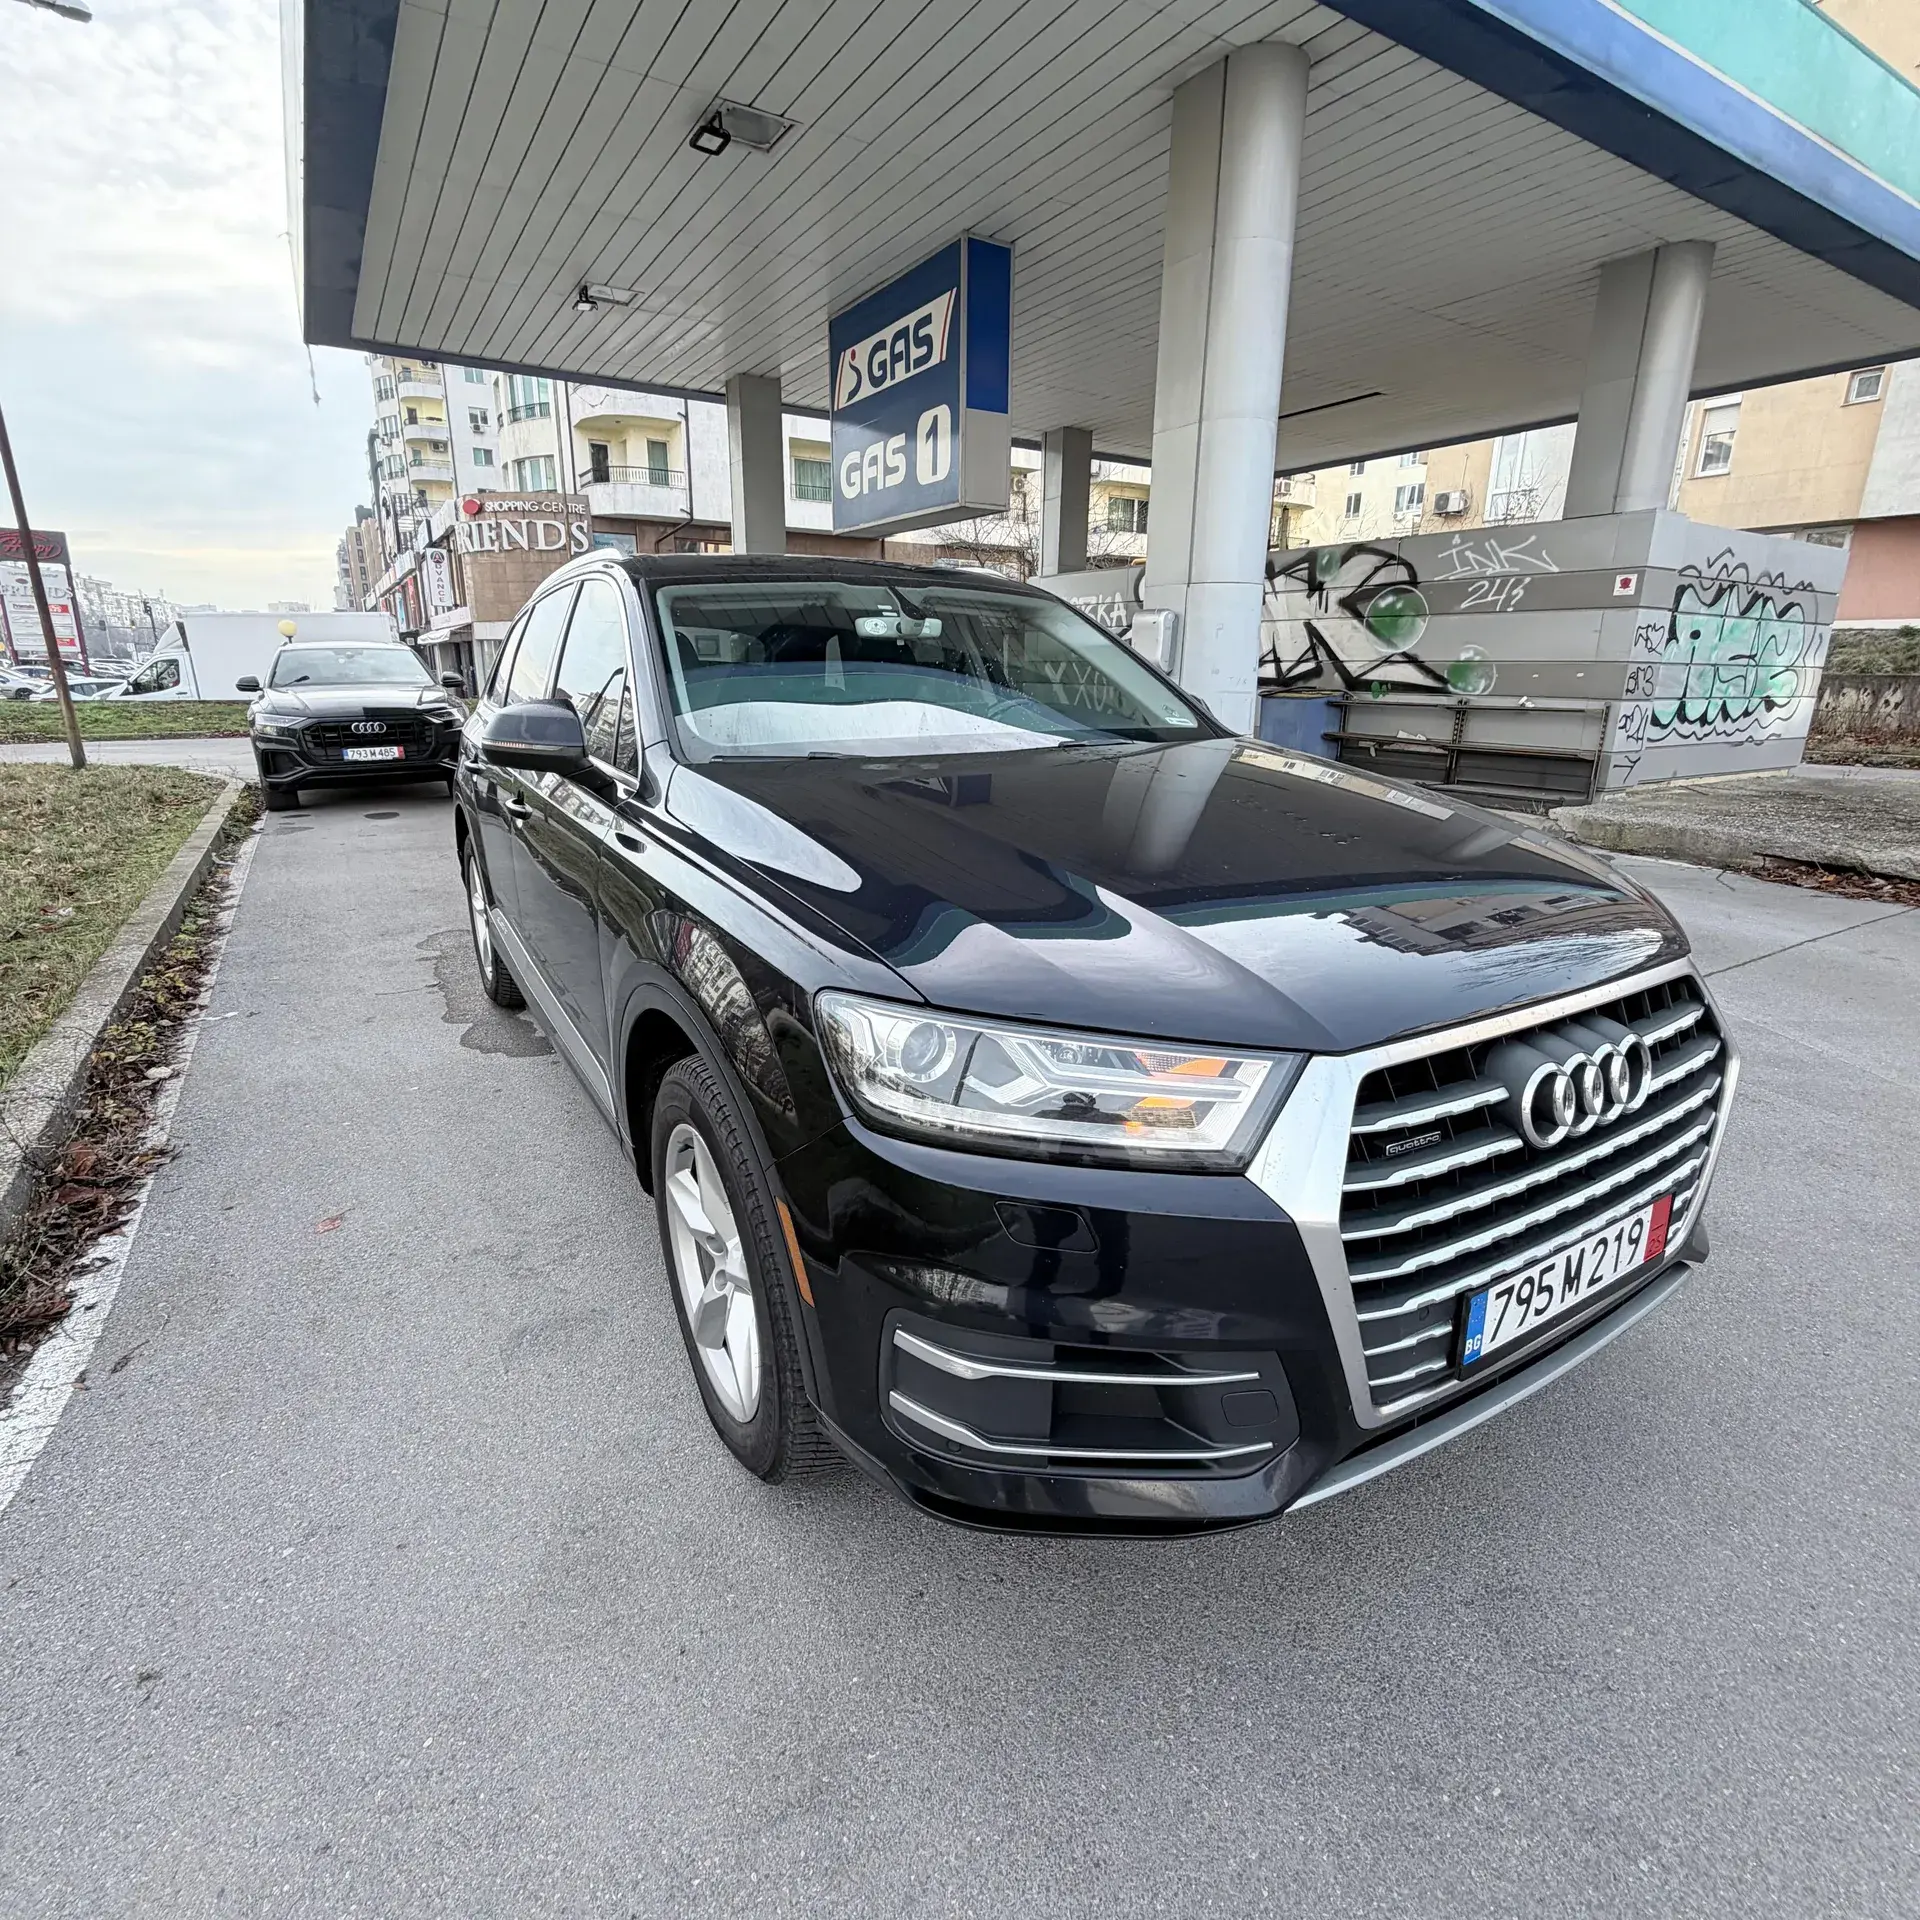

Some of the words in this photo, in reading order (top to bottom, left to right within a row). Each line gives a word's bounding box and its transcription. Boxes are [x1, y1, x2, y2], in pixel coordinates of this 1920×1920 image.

[839, 432, 907, 500] GAS
[925, 413, 939, 477] 1
[484, 500, 539, 513] SHOPPING
[541, 501, 586, 515] CENTRE
[430, 551, 446, 603] ADVANCE
[1389, 1134, 1440, 1154] quattro
[1488, 1217, 1645, 1344] 795M219
[1464, 1334, 1482, 1355] BG
